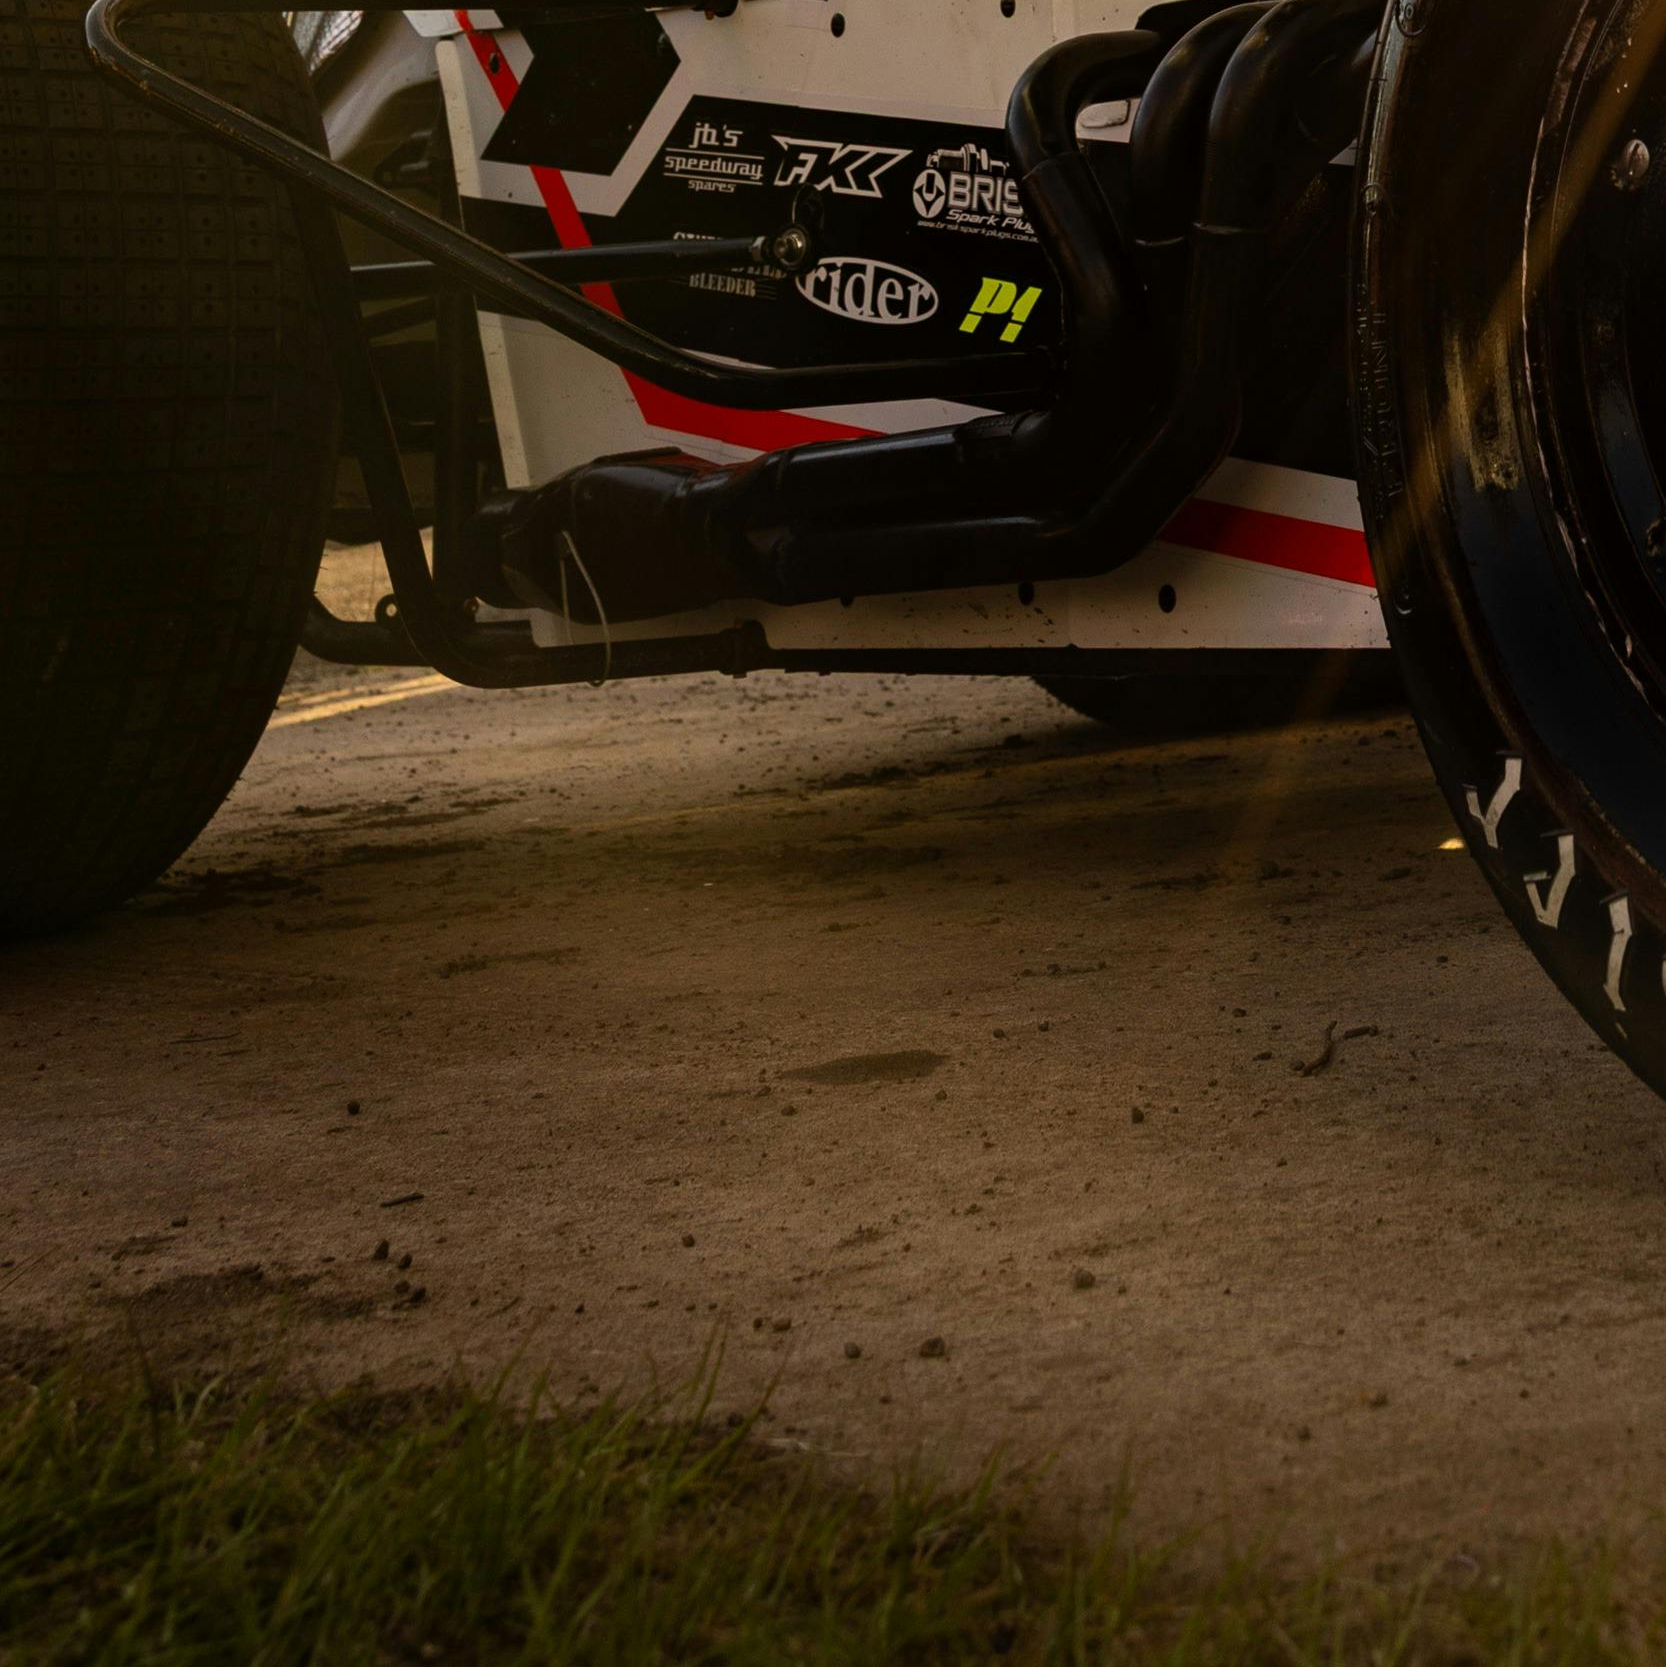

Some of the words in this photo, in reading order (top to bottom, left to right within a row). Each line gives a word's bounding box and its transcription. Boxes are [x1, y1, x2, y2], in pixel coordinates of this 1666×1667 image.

[664, 155, 764, 180] speedway
[688, 179, 737, 193] spares
[945, 208, 1000, 227] Spark
[688, 272, 757, 298] BLEEDER
[804, 264, 932, 321] rider
